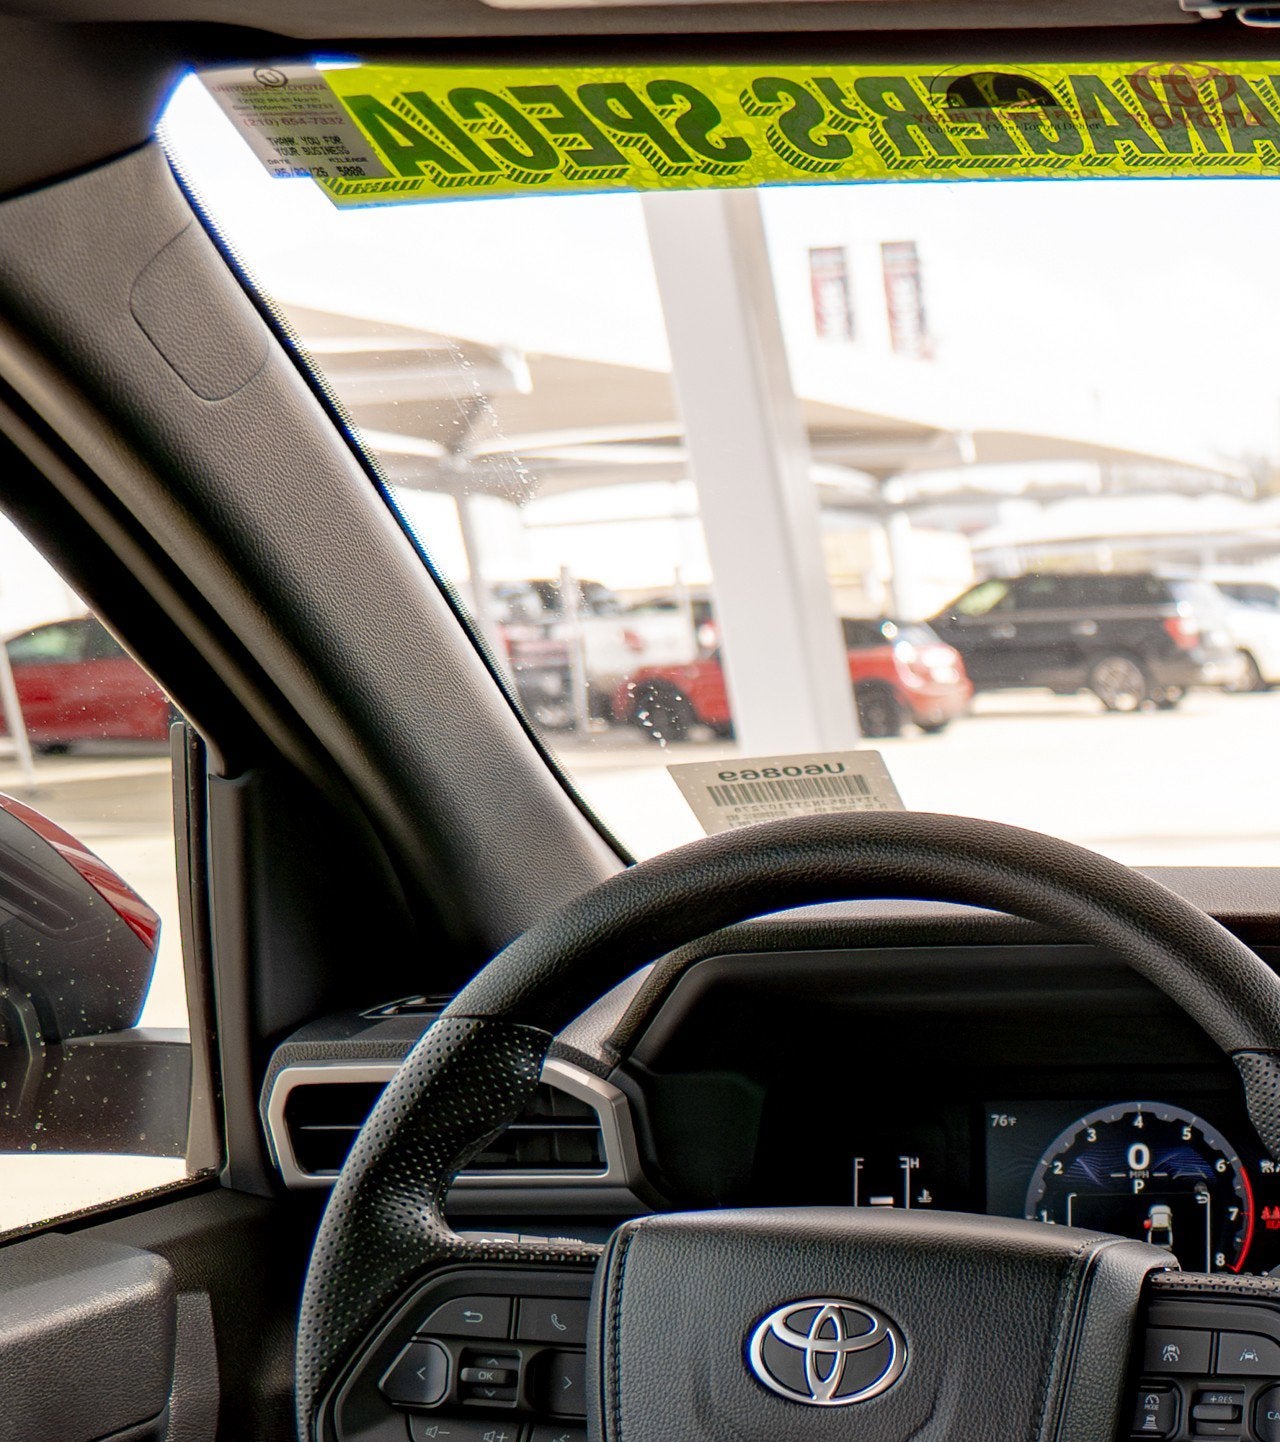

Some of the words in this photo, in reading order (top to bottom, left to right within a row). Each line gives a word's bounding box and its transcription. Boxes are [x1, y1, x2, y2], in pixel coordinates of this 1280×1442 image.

[282, 83, 328, 92] TOYOTA
[1131, 112, 1267, 131] TOYOTA
[266, 136, 295, 147] THANK
[300, 136, 320, 146] YOU
[324, 136, 342, 145] FOR
[274, 147, 300, 157] YOUR
[302, 146, 350, 157] BUSINESS
[1133, 1114, 1143, 1128] 4
[1086, 1128, 1097, 1142] 3
[1181, 1128, 1192, 1141] 5
[1127, 1142, 1150, 1171] 0
[1053, 1161, 1063, 1175] 2
[1215, 1159, 1226, 1173] 6
[1129, 1170, 1149, 1178] MPH
[1133, 1180, 1145, 1194] P
[1228, 1207, 1238, 1221] 7
[1215, 1253, 1225, 1267] 8
[478, 1372, 494, 1381] OK
